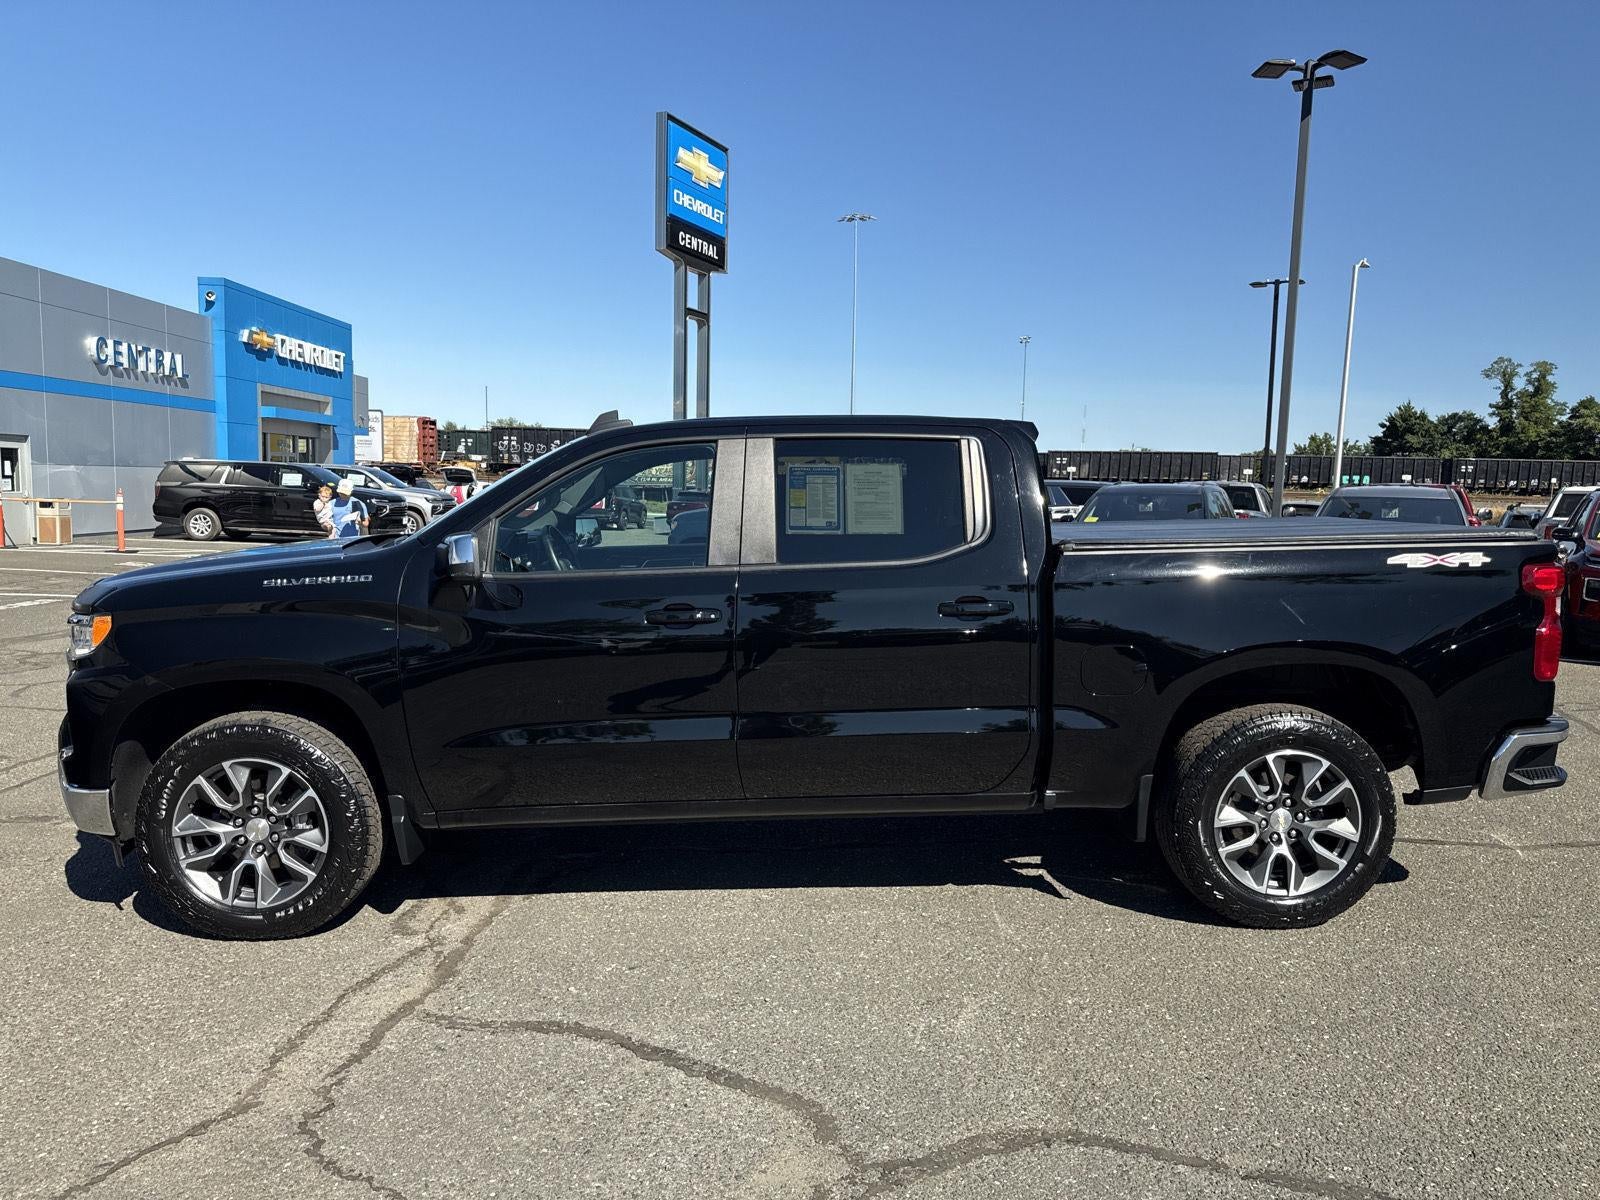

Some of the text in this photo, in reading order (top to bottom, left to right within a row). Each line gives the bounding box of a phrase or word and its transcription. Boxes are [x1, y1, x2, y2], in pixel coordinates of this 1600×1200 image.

[673, 189, 725, 225] CHEVROLET
[678, 231, 719, 260] CENTRAL
[88, 336, 190, 379] CENTRAL
[275, 333, 345, 373] CHEVROLET
[262, 574, 373, 587] SILVERADO
